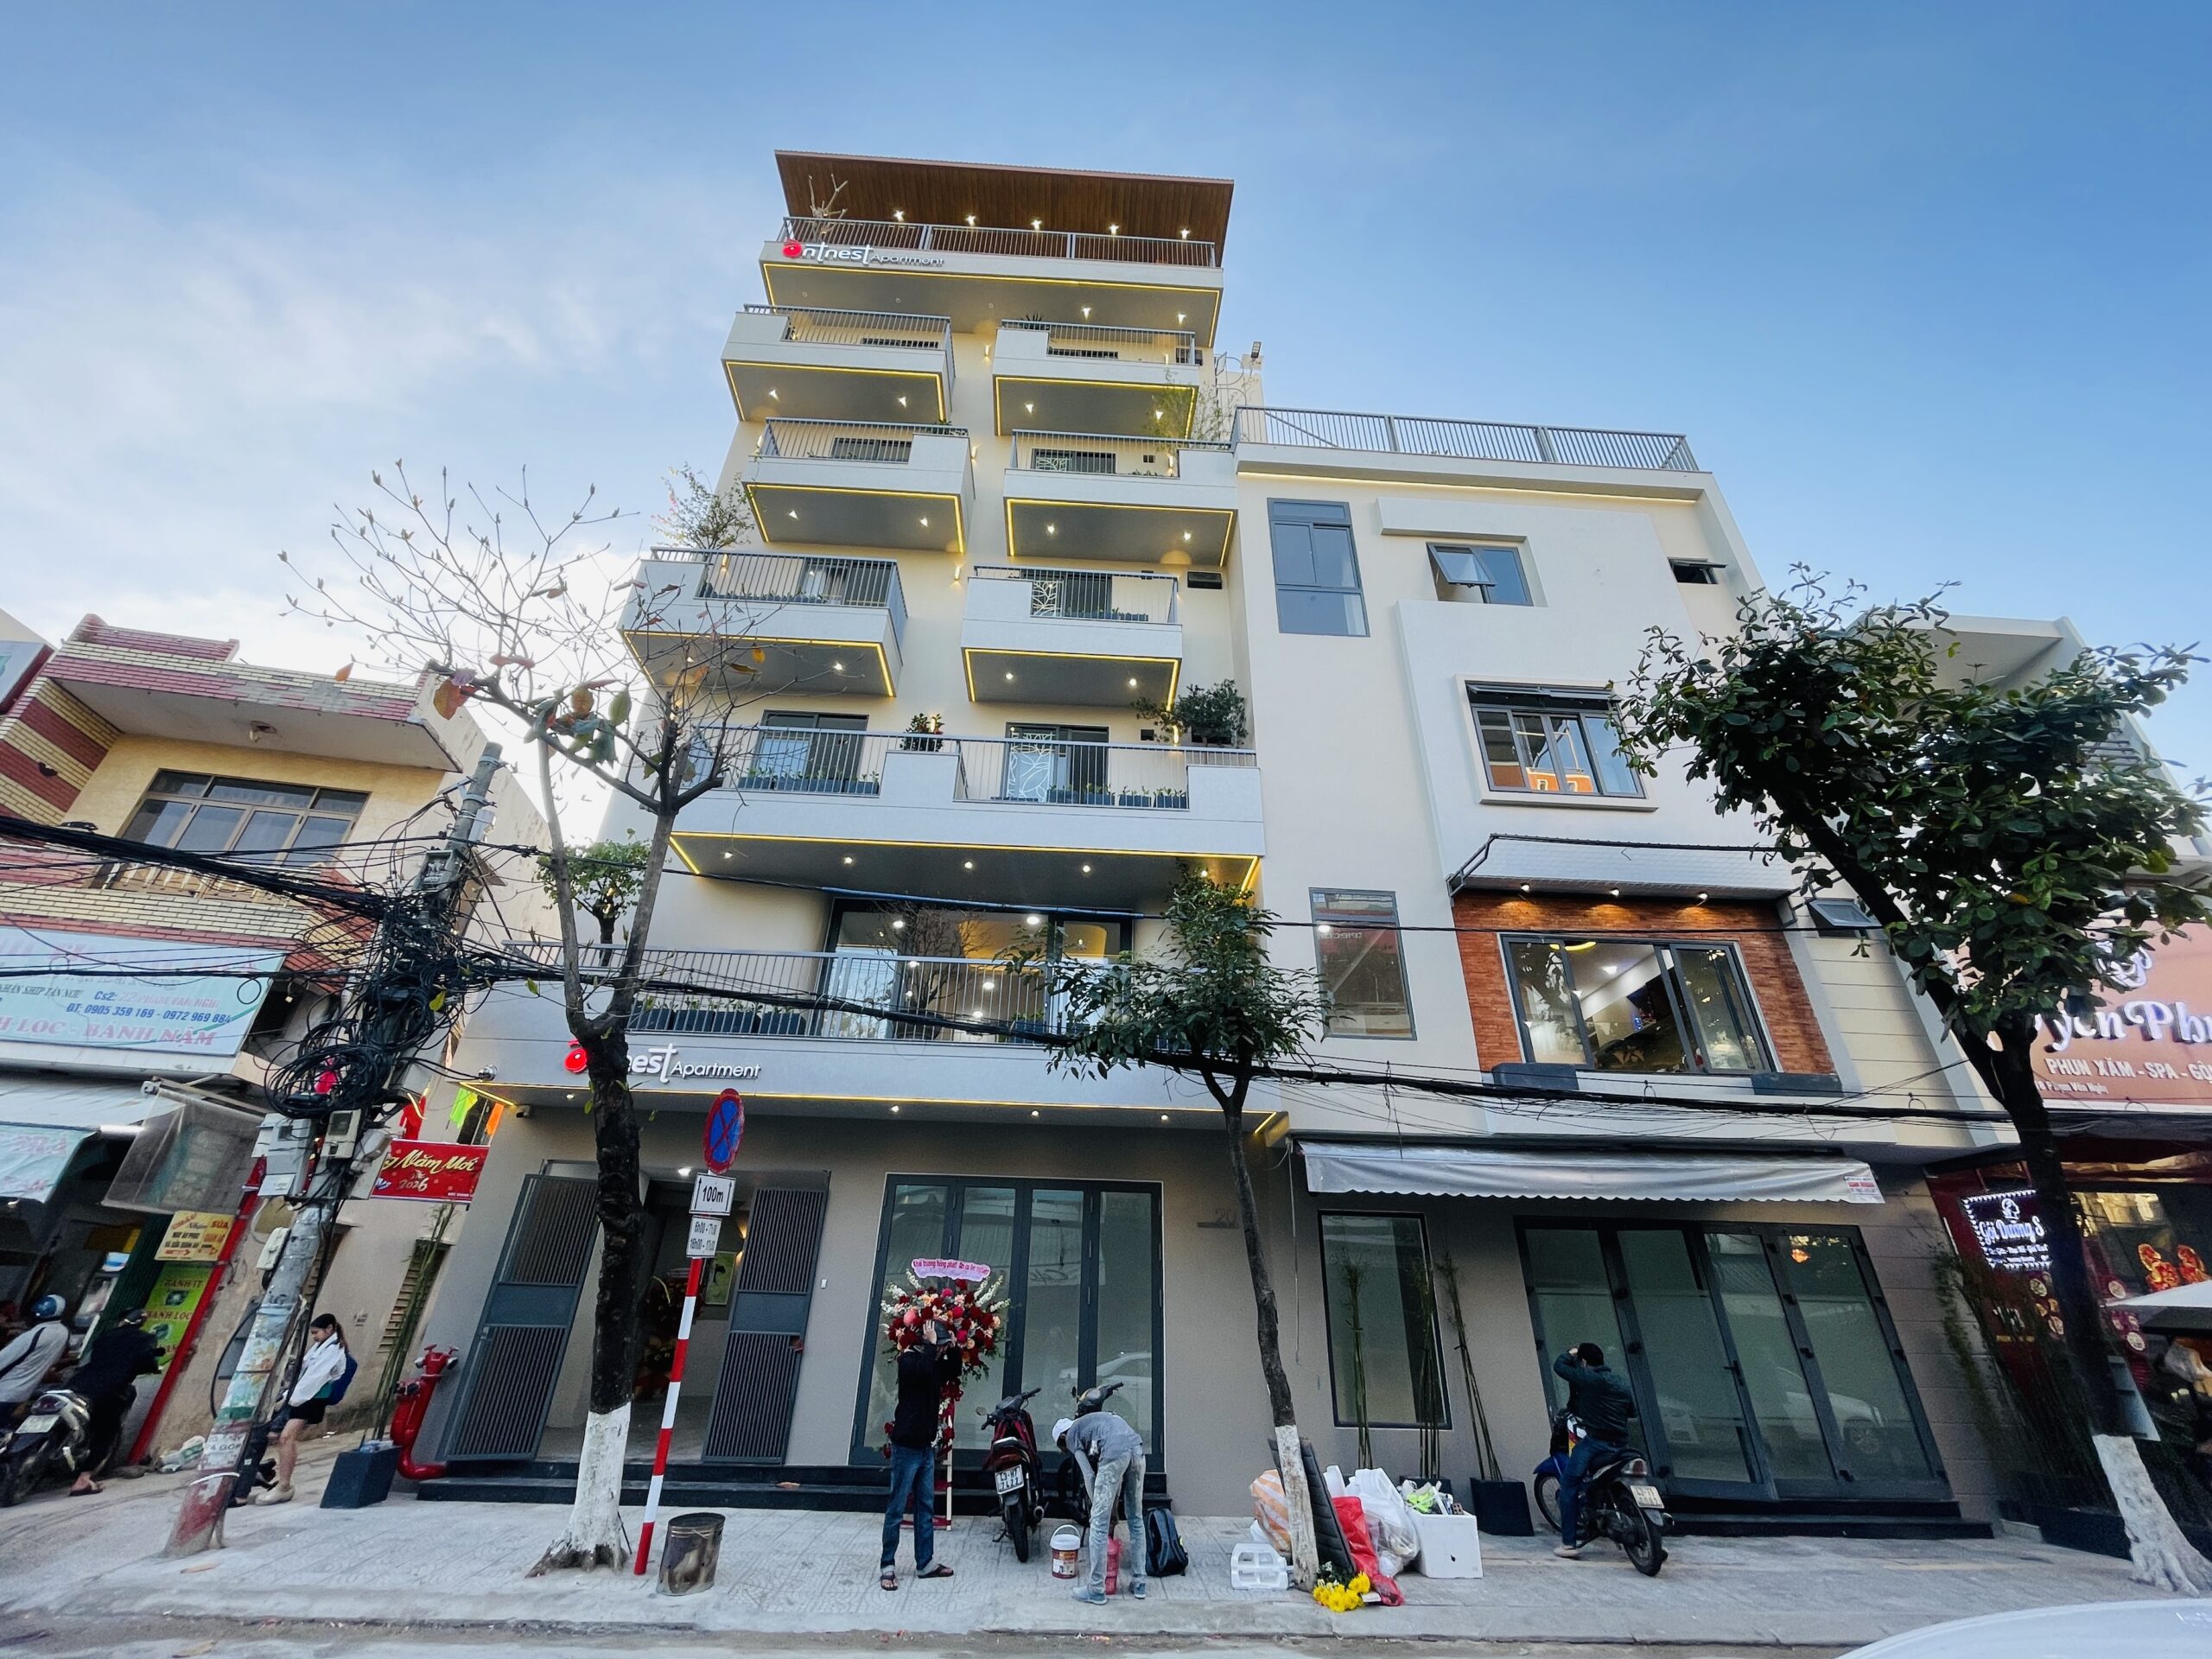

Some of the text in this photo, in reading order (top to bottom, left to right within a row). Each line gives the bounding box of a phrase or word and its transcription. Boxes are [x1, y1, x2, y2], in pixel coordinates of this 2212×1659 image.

[84, 1004, 111, 1015] 0905
[112, 1006, 133, 1017] 359
[136, 1007, 155, 1019] 169
[162, 1010, 188, 1021] 0972
[191, 1012, 212, 1023] 969
[671, 1061, 761, 1079] Apartment
[2044, 1058, 2093, 1077] PHUN
[2144, 1061, 2179, 1079] SPA
[702, 1186, 724, 1204] 100m
